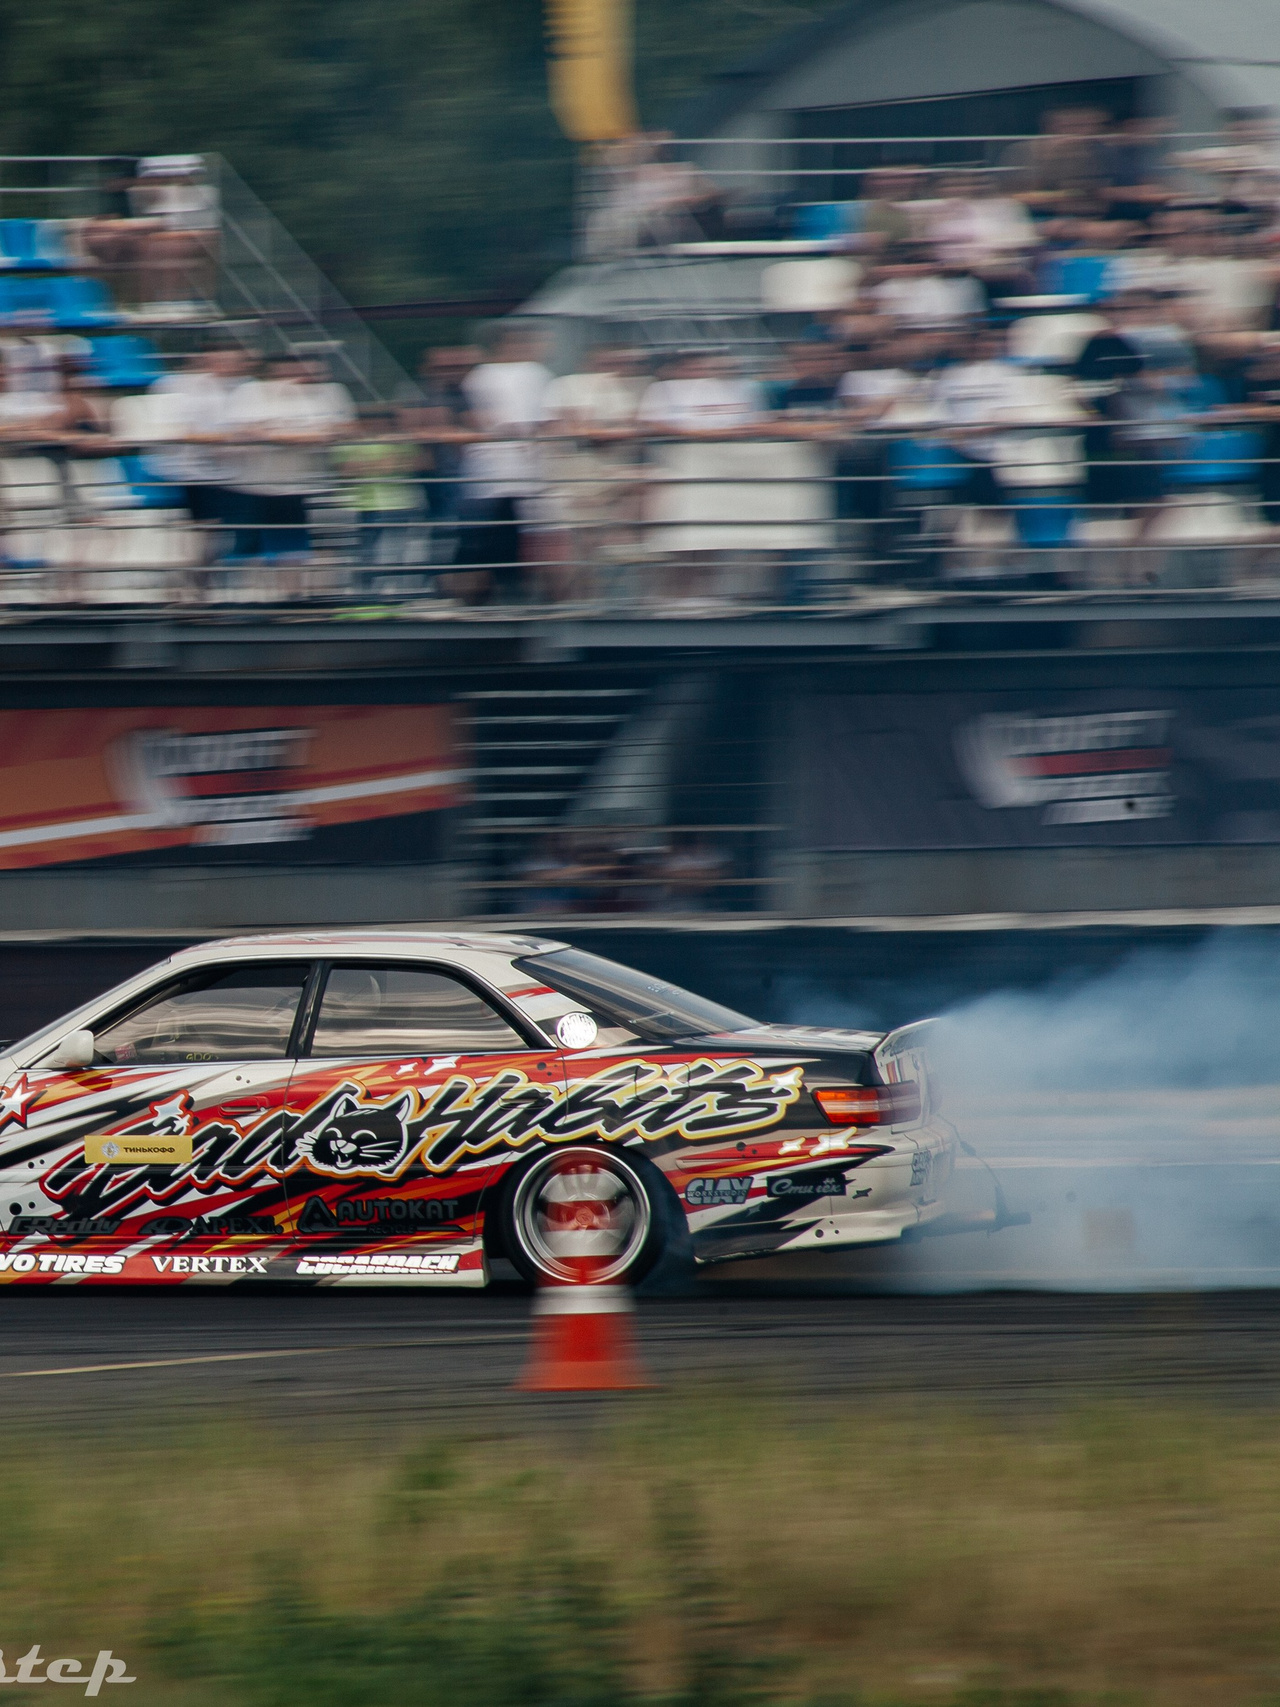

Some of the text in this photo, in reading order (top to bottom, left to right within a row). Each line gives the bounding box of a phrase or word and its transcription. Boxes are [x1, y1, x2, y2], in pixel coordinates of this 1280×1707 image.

[337, 1200, 459, 1220] AUTOKAT
[10, 1217, 122, 1234] GReddy
[368, 1224, 418, 1235] RECYCLE
[38, 1255, 125, 1273] TIRES
[151, 1256, 269, 1273] VERTEX
